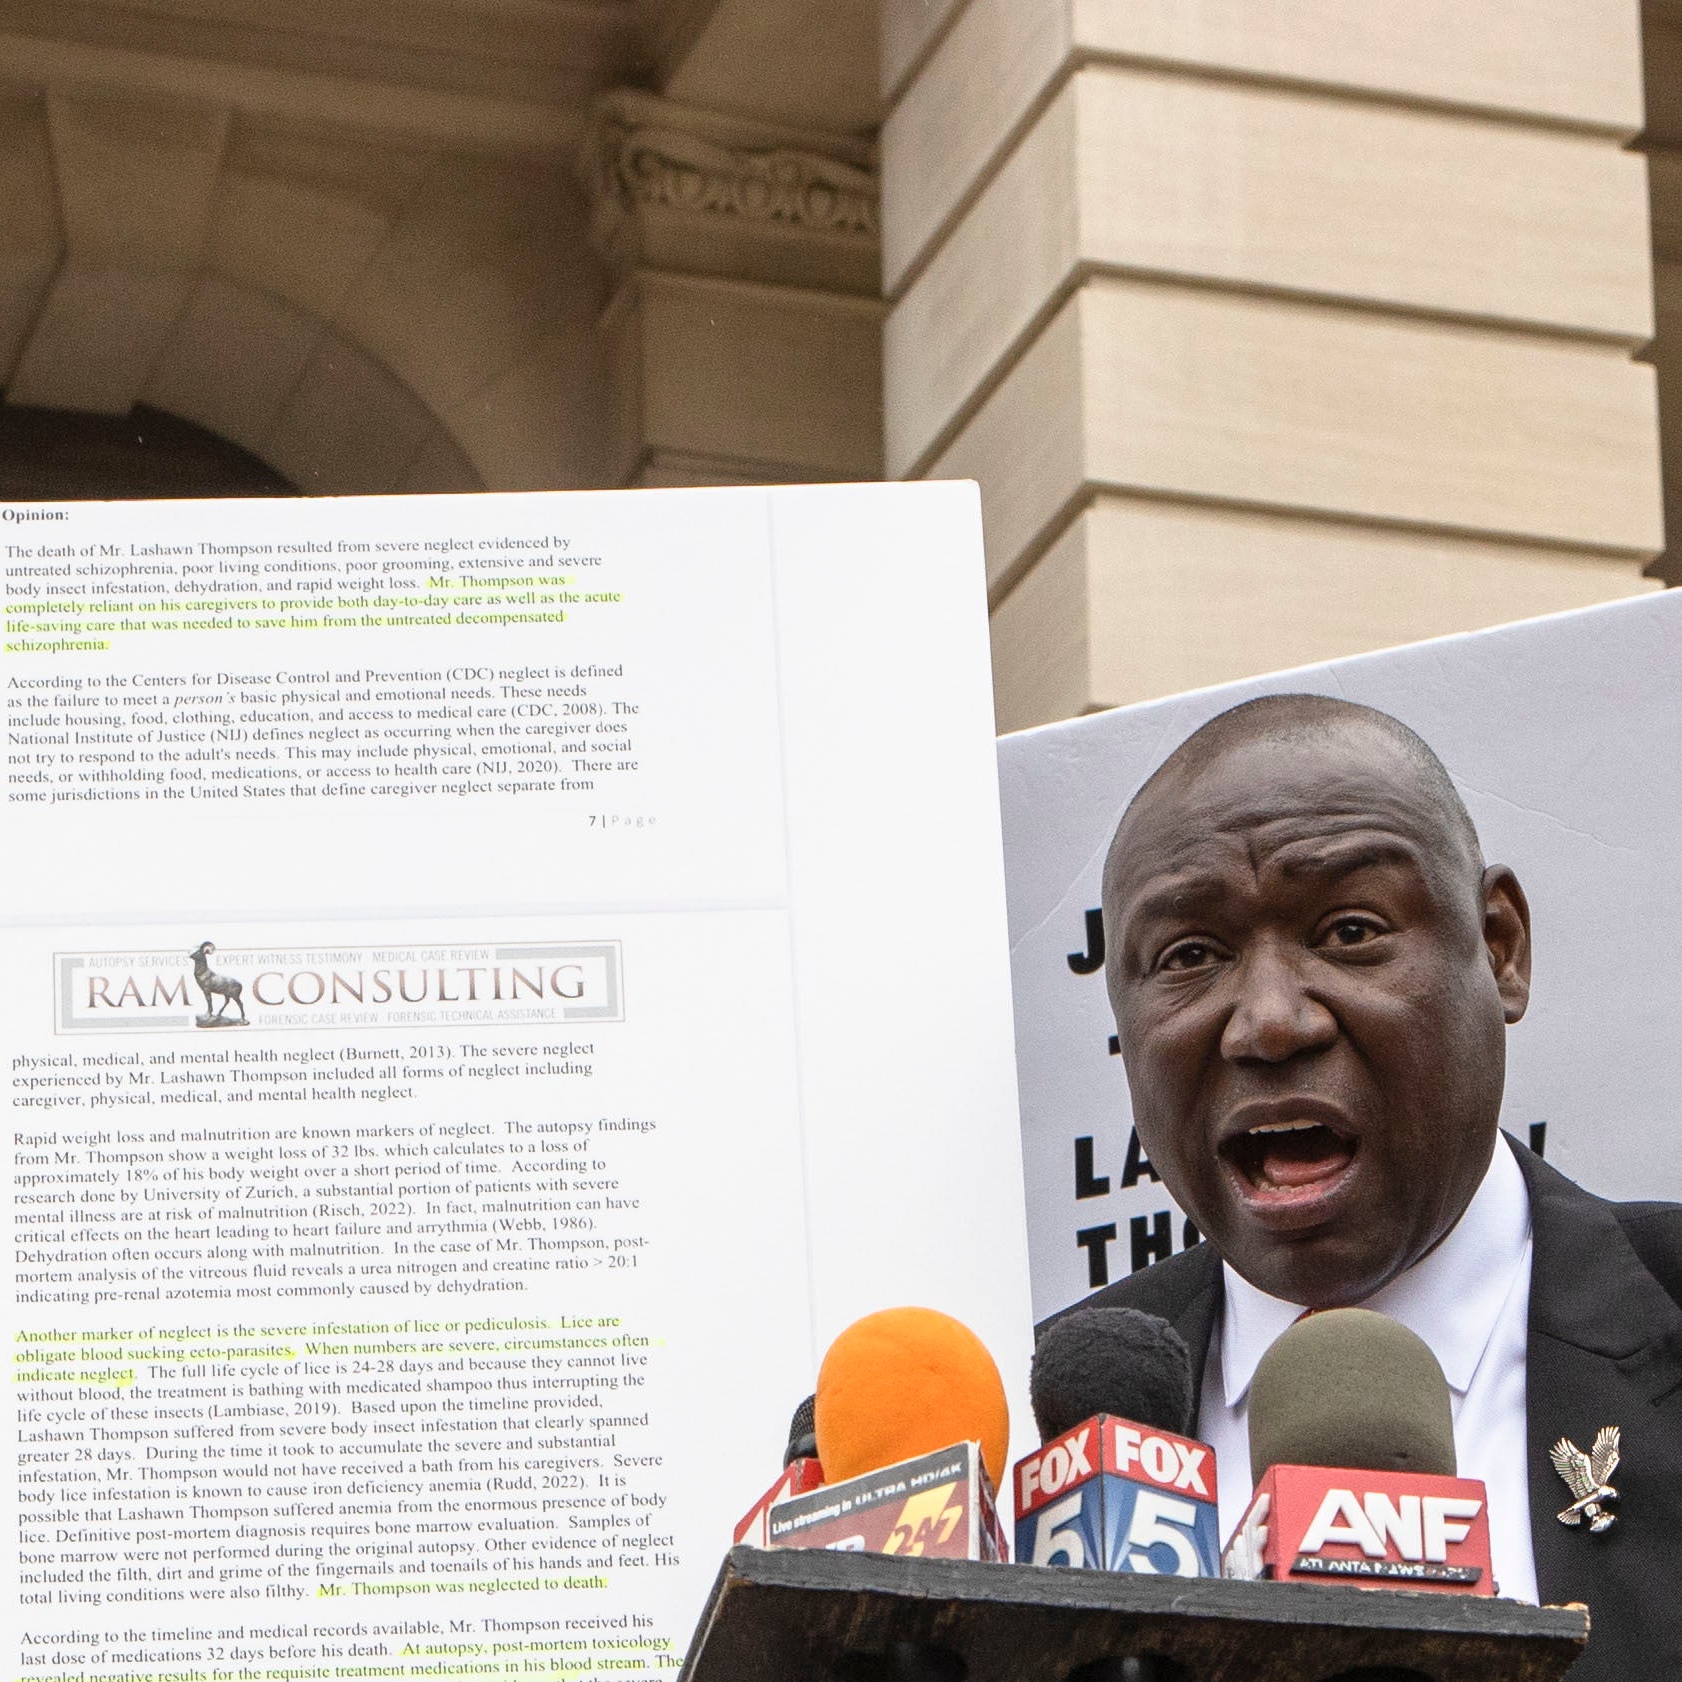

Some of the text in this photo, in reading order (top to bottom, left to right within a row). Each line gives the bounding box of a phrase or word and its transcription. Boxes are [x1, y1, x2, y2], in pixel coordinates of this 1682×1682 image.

[2, 510, 68, 524] Opinion:
[6, 536, 570, 558] The death of Mr. Lashawn Thompson resulted from severe neglect evidenced by
[6, 552, 601, 578] untreated schizophrenia, poor living conditions, poor grooming, extensive and severe
[88, 964, 585, 1009] RAM CONSULTING
[13, 1042, 594, 1071] physical, medical, and mental health neglect (Burnett, 2013). The severe neglect
[1021, 1428, 1092, 1510] FOX
[1114, 1425, 1208, 1495] FOX
[772, 1518, 793, 1535] Live
[855, 1482, 906, 1506] ULTRA
[1298, 1489, 1482, 1563] ANF
[1128, 1490, 1201, 1577] 5
[20, 1575, 607, 1606] total living conditions were also filthy. Mr. Thompson was neglected to death.
